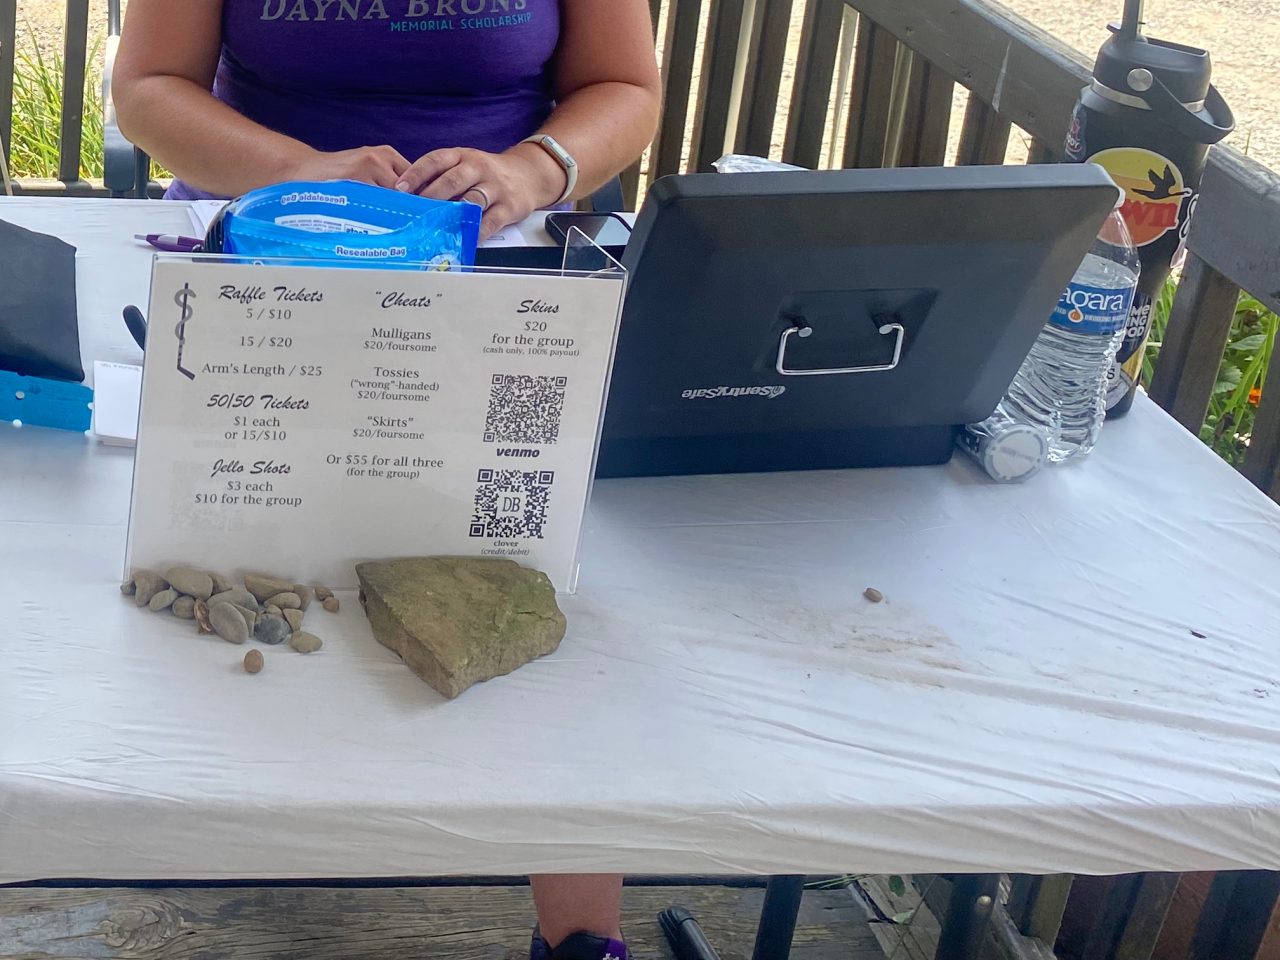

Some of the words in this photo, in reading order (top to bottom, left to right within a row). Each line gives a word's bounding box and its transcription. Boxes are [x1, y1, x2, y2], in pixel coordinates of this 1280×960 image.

[390, 19, 455, 32] MEMORIAL
[460, 12, 533, 29] SCHOLARSHIP
[336, 246, 387, 257] Resealable
[390, 247, 406, 256] Bag
[219, 286, 266, 304] Raffle
[274, 286, 322, 302] Tickets
[1060, 287, 1123, 310] agara
[517, 300, 558, 313] Skins
[246, 308, 253, 318] 5
[269, 309, 291, 319] $10
[524, 321, 546, 331] $20
[372, 328, 431, 341] Mulligans
[242, 336, 253, 346] 15
[270, 337, 292, 347] $20
[364, 341, 436, 352] $20/foursome
[492, 334, 510, 344] for
[515, 334, 533, 344] the
[537, 338, 574, 348] group
[506, 347, 524, 355] only,
[202, 364, 238, 373] Arm's
[244, 364, 284, 376] Length
[300, 366, 322, 376] $25
[375, 367, 419, 378] Tossies
[358, 391, 429, 401] $20/foursome
[681, 386, 772, 399] SentrySafe
[207, 393, 254, 408] 50/50
[260, 395, 308, 409] Tickets
[234, 416, 246, 426] $1
[253, 417, 280, 426] each
[244, 430, 286, 441] 15/$10
[353, 428, 424, 439] $20/foursome
[497, 448, 540, 457] venmo
[327, 455, 341, 464] Or
[346, 455, 367, 464] $55
[372, 456, 390, 465] for
[394, 457, 408, 466] all
[413, 457, 443, 467] three
[211, 459, 244, 477] Jello
[250, 460, 290, 474] Shots
[347, 468, 365, 476] (for
[368, 468, 383, 476] the
[386, 471, 419, 479] group)
[227, 481, 240, 490] $3
[246, 482, 272, 491] each
[196, 494, 217, 503] $10
[222, 494, 239, 503] for
[244, 494, 262, 504] the
[266, 498, 302, 507] group
[502, 497, 520, 512] DB
